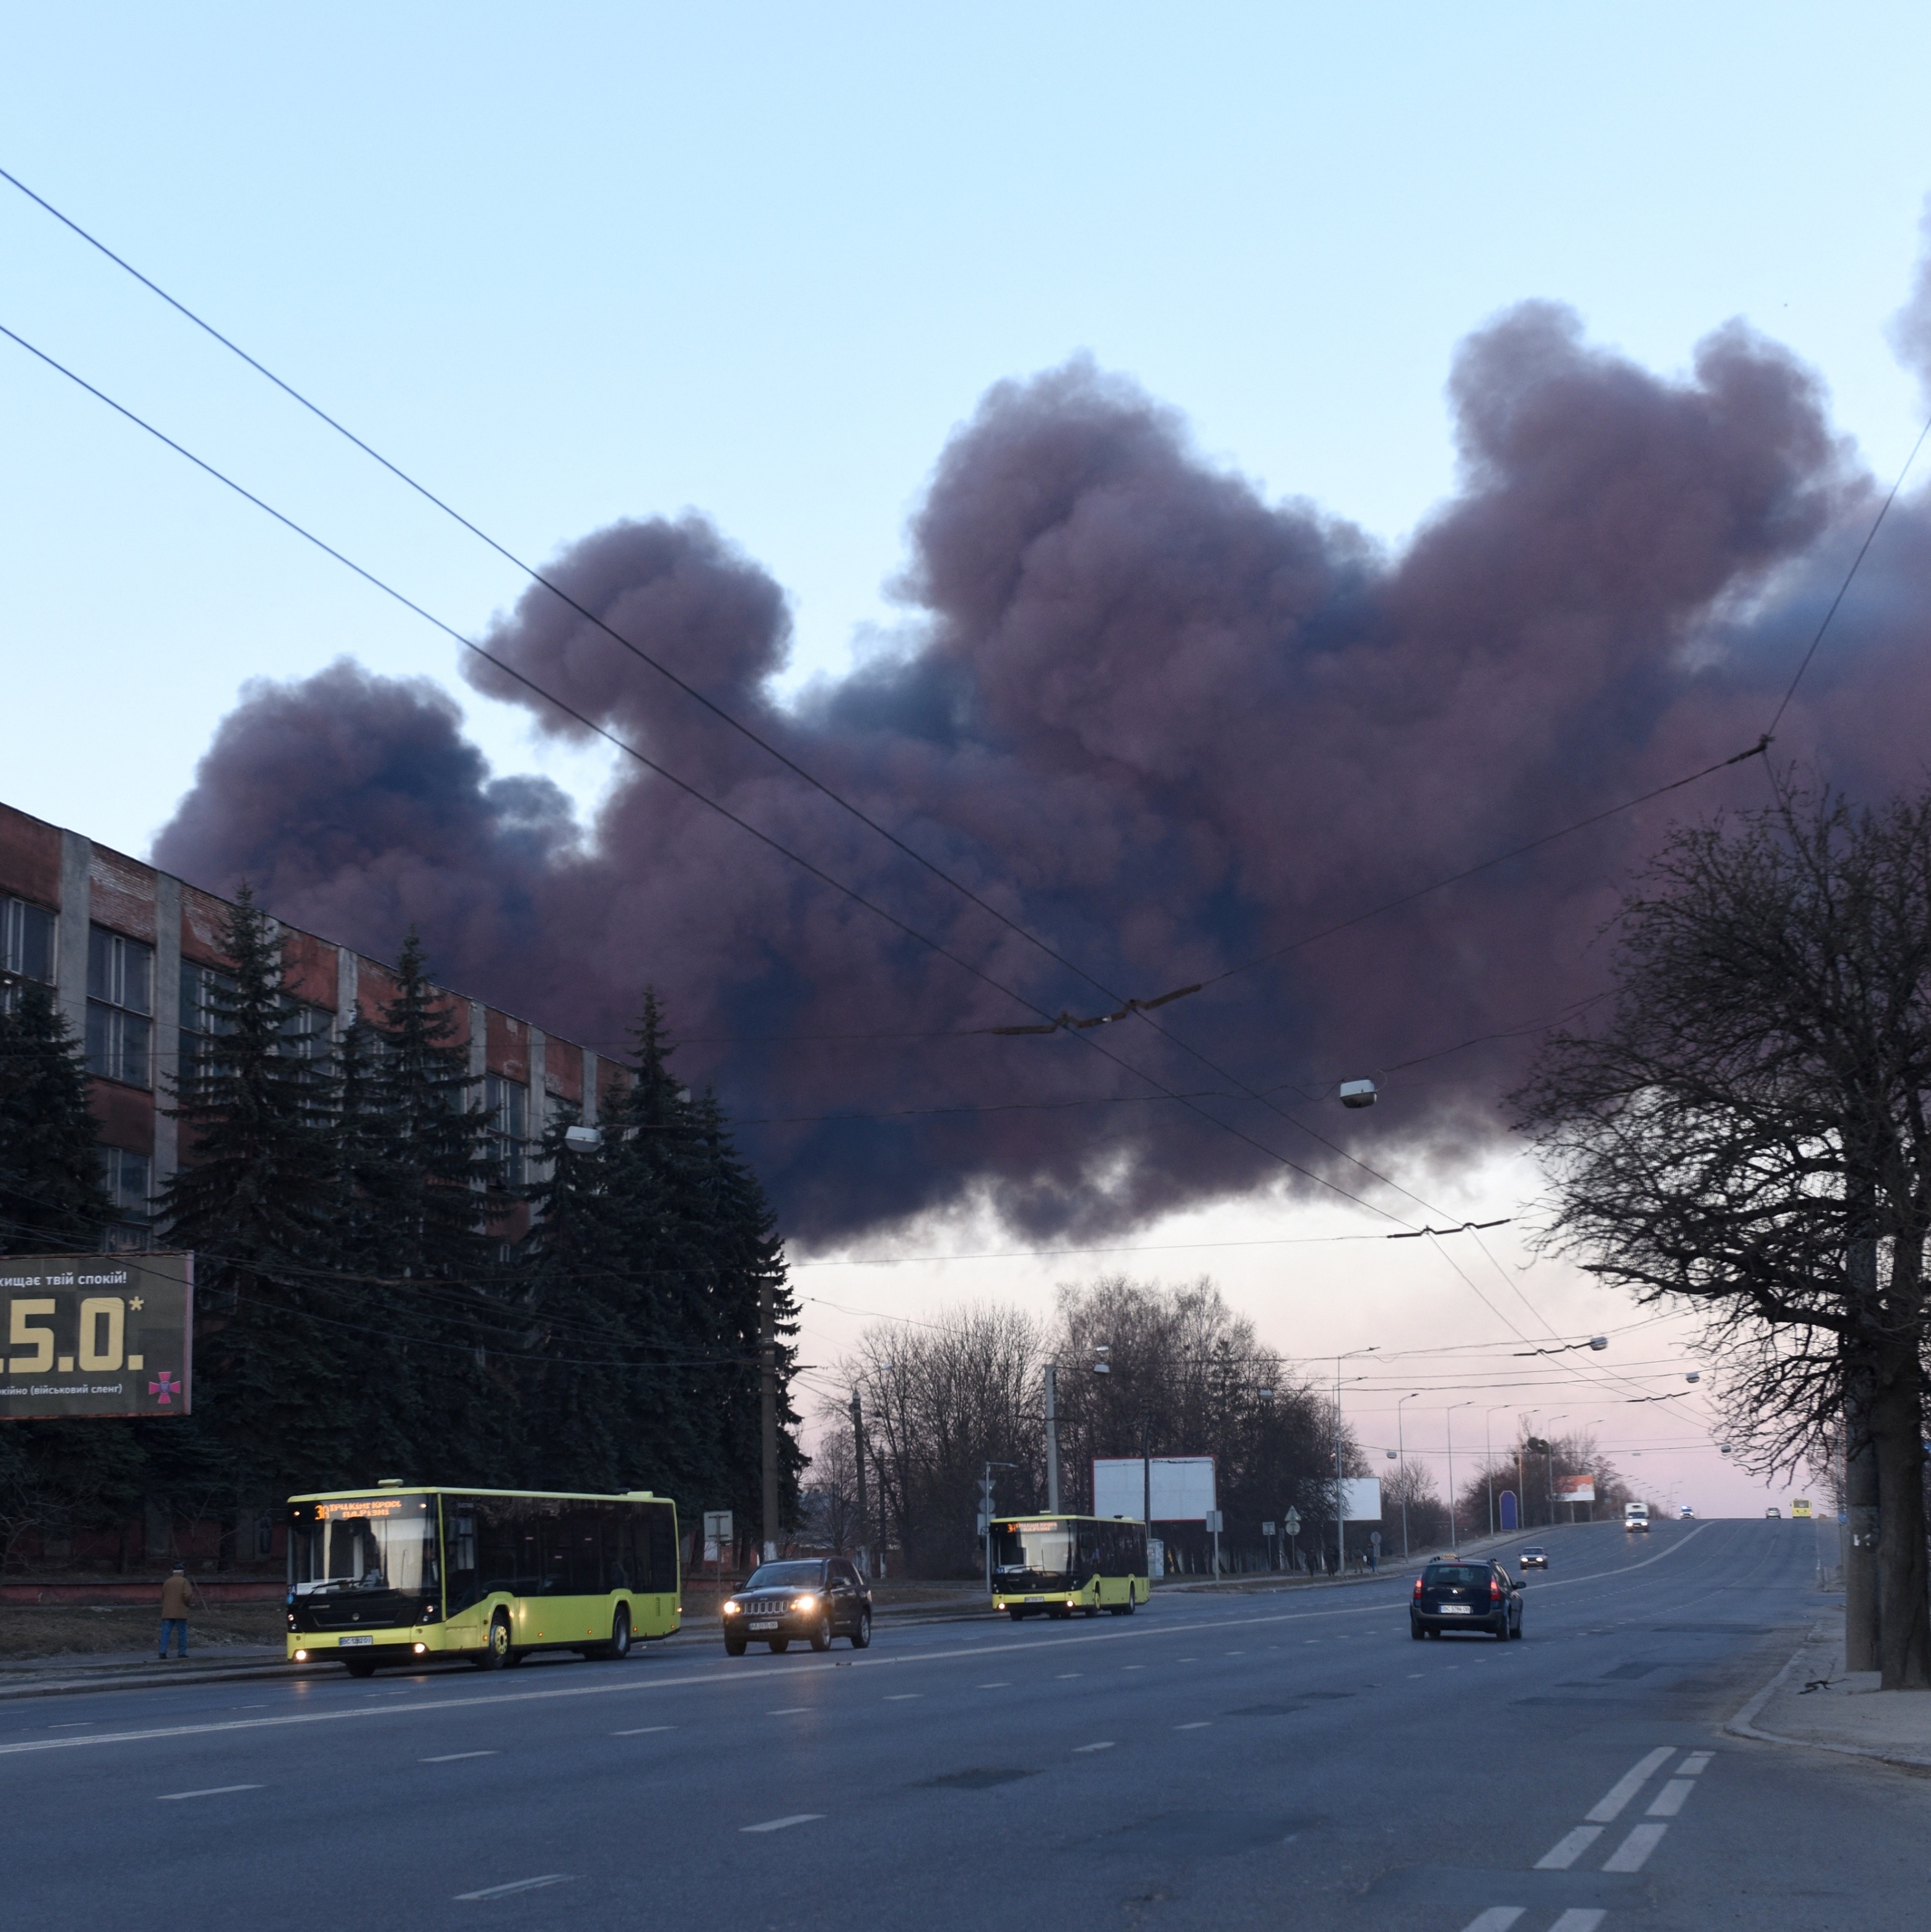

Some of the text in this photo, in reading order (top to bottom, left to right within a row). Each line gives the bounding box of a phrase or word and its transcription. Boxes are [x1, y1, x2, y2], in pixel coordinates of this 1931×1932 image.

[45, 1272, 74, 1285] твій
[78, 1271, 127, 1284] спокій!
[0, 1383, 122, 1396] кійно (військовий сленг)
